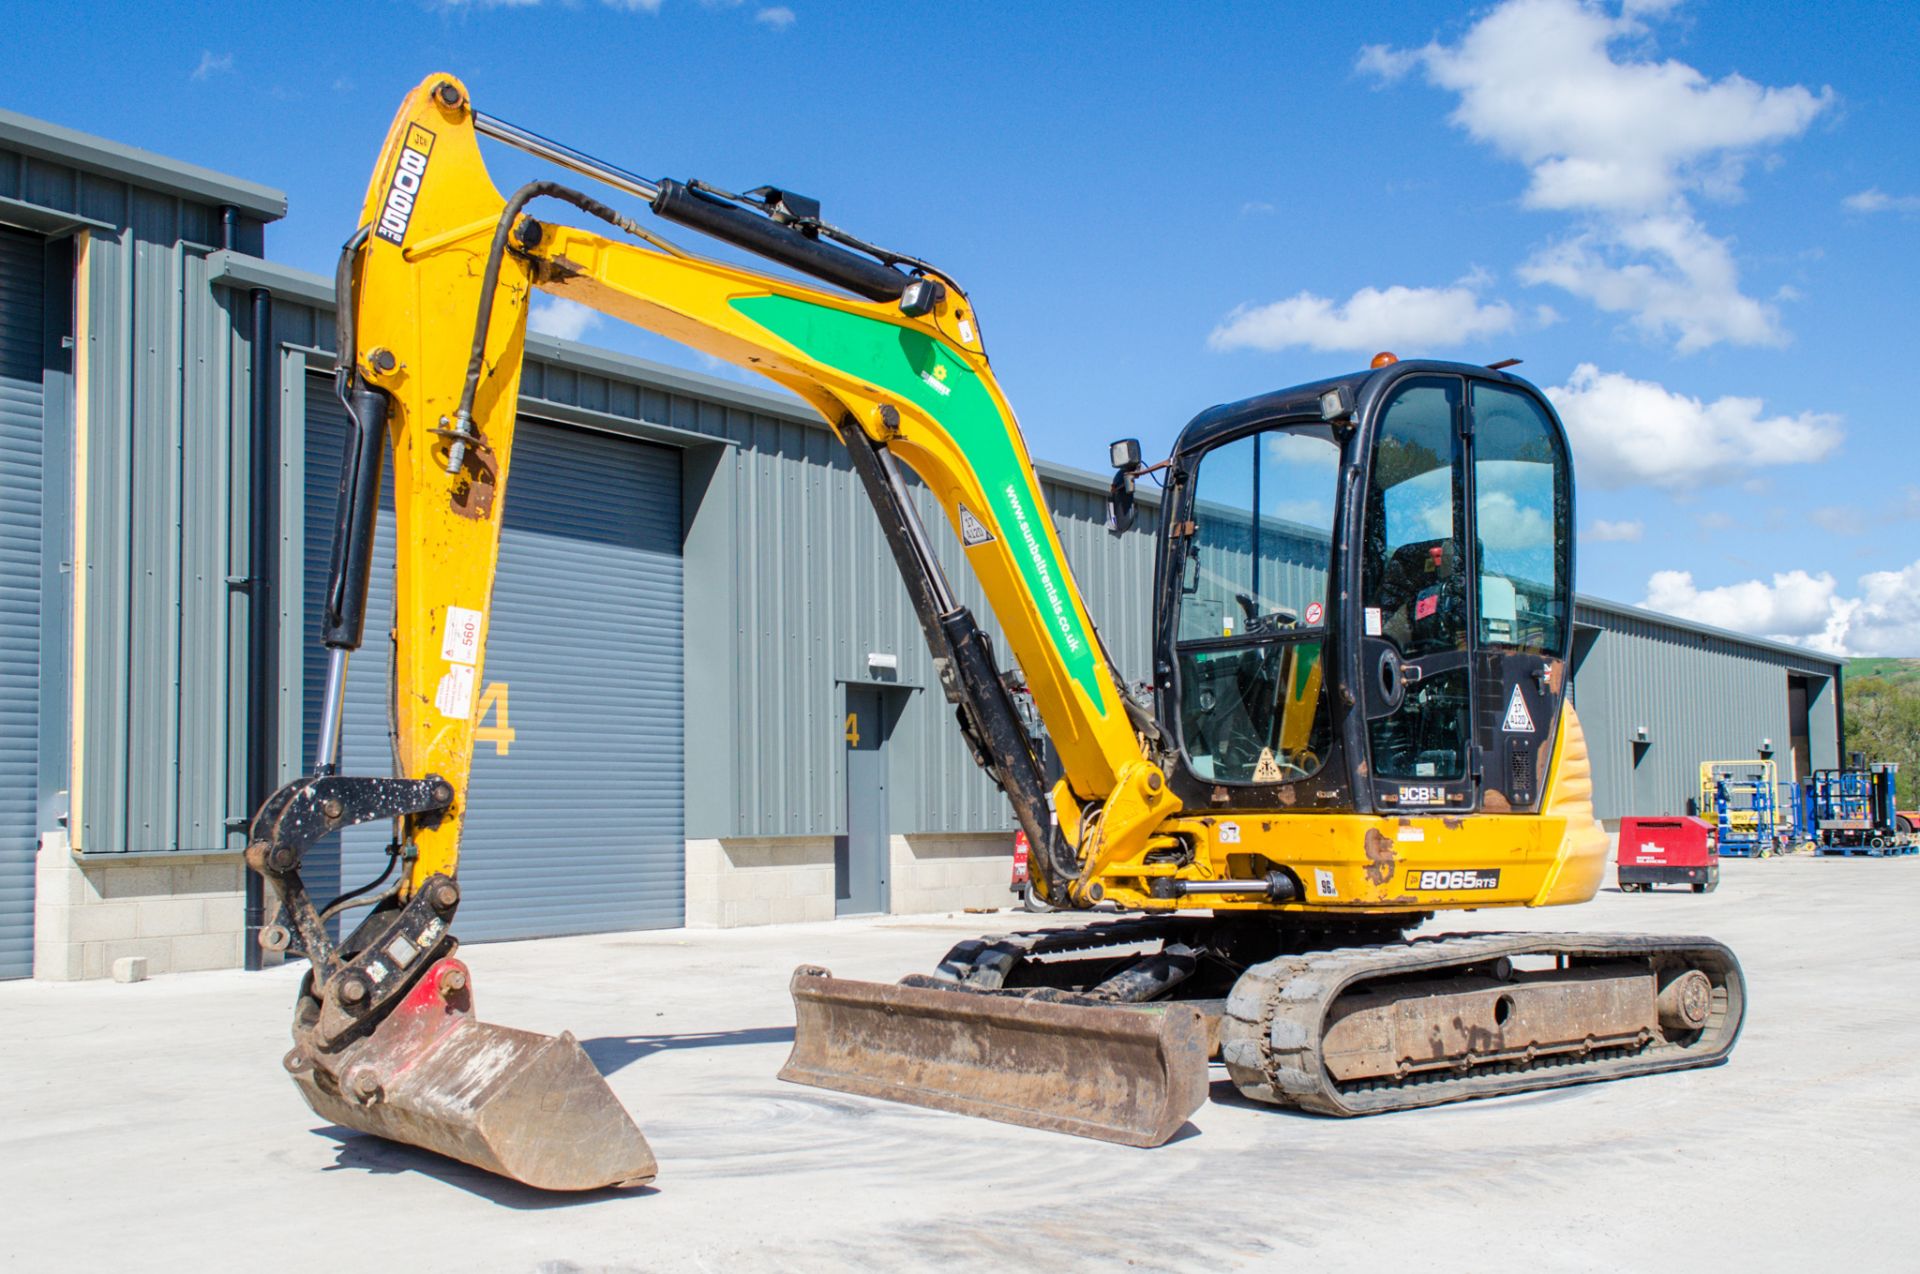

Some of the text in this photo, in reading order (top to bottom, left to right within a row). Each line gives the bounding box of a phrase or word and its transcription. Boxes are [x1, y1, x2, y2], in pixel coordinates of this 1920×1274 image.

[1005, 484, 1080, 653] www.sunbeltrentals.co.uk
[462, 622, 475, 647] 560
[475, 682, 515, 756] 4
[846, 712, 860, 748] 4
[1399, 786, 1430, 801] JCB
